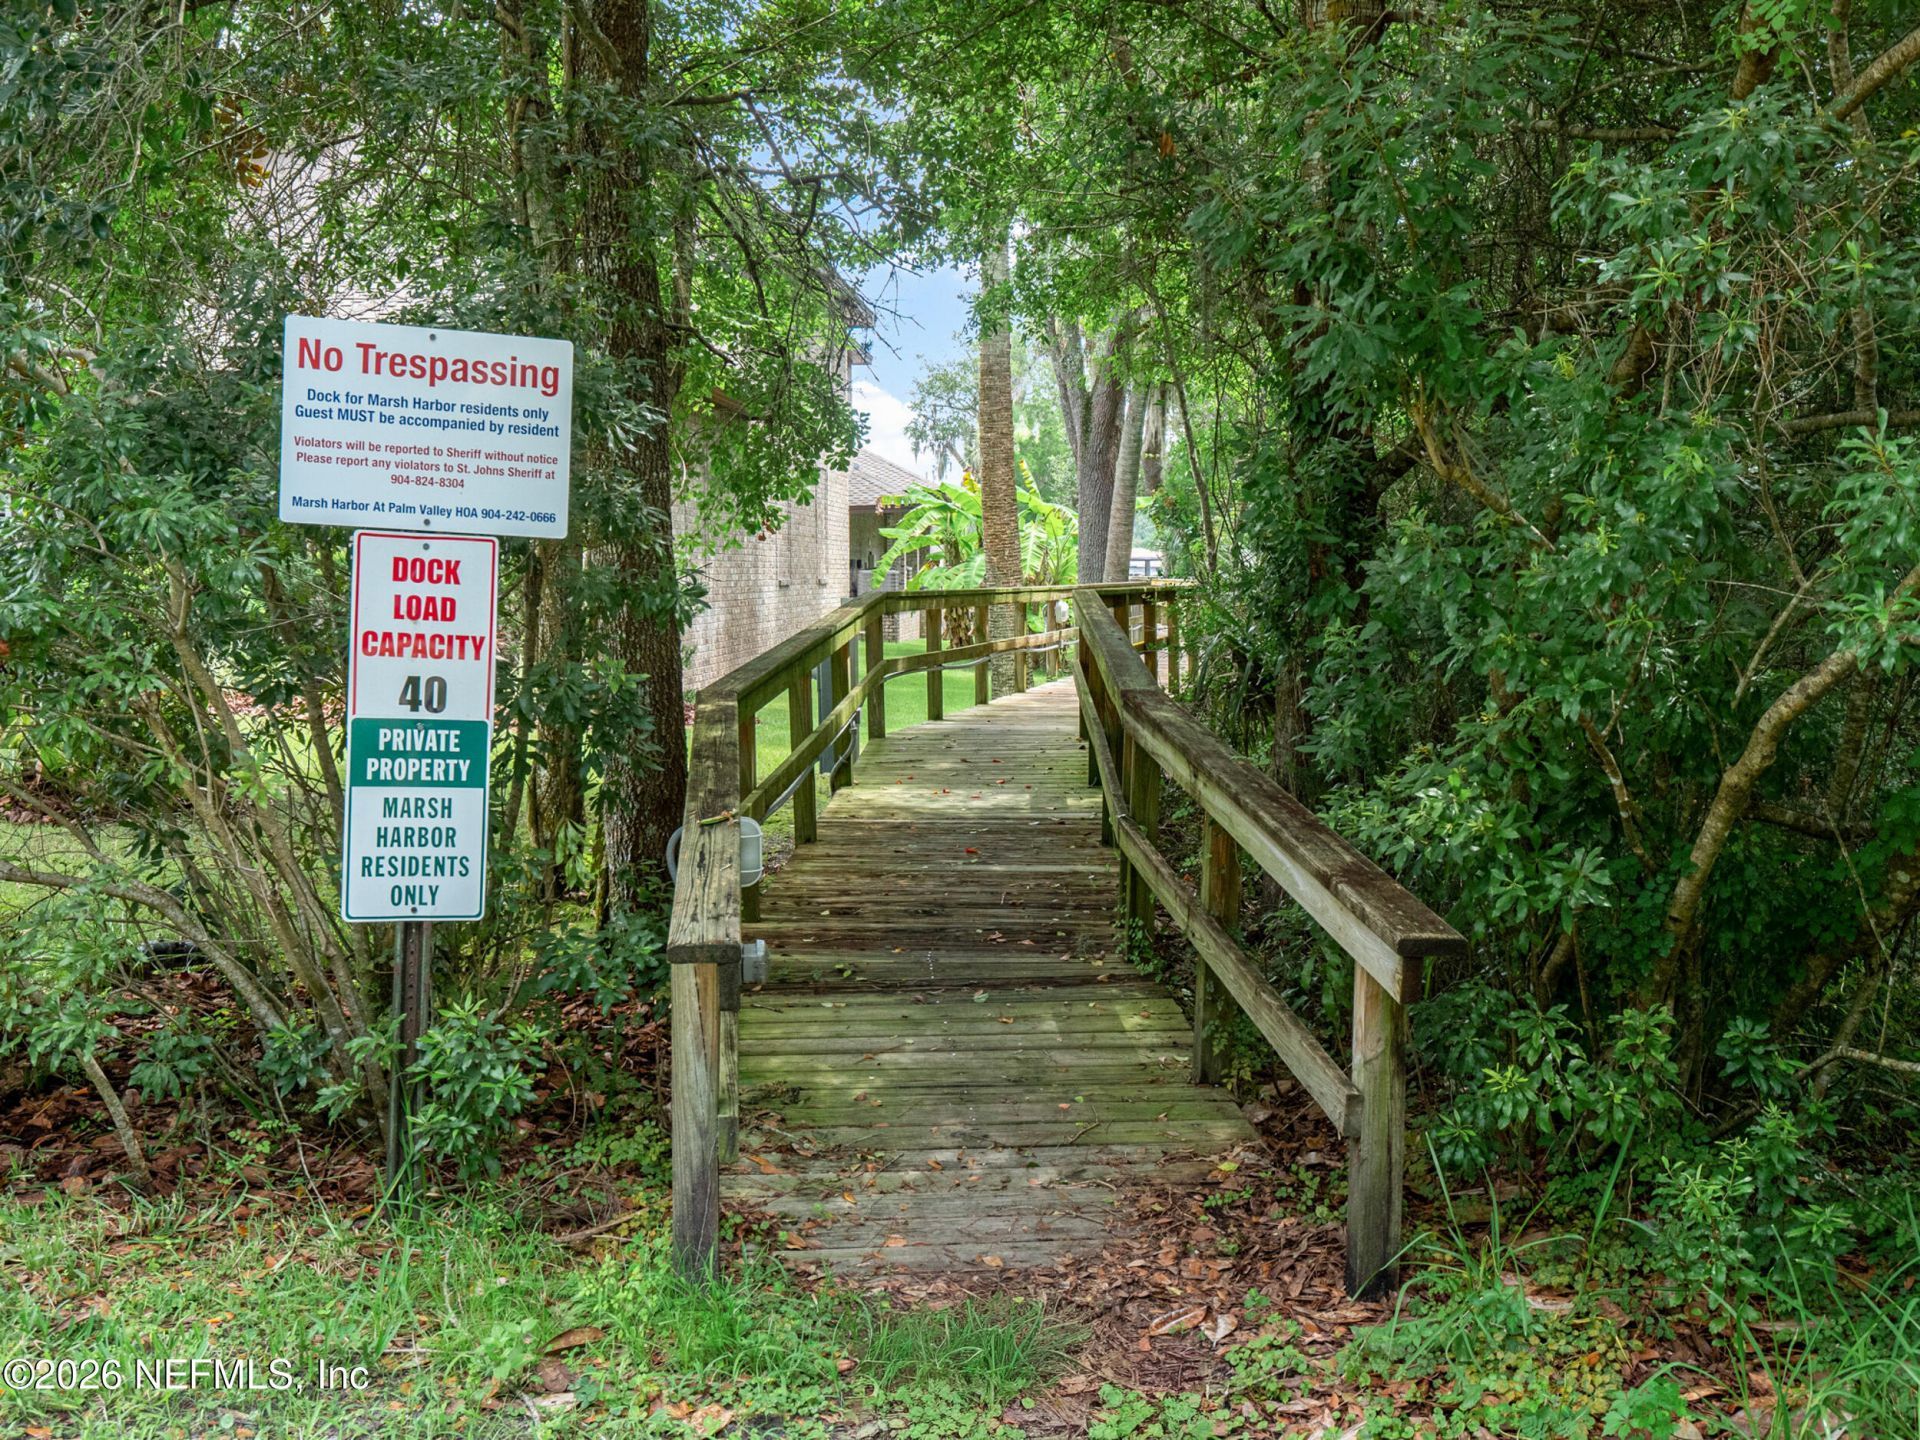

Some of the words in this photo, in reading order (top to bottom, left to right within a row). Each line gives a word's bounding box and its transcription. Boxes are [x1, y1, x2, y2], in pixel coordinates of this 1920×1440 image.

[298, 338, 343, 372] No
[356, 342, 560, 397] Trespassing
[307, 388, 340, 403] Dock
[345, 392, 363, 404] for
[368, 393, 408, 408] Marsh
[413, 397, 456, 412] Harbor
[460, 400, 519, 417] residents
[522, 406, 549, 421] only
[295, 404, 333, 420] Guest
[337, 410, 374, 422] MUST
[379, 412, 394, 424] be
[399, 415, 485, 434] accompanied
[489, 418, 504, 434] by
[508, 422, 560, 437] resident
[294, 436, 342, 450] Violators
[346, 440, 365, 451] will
[368, 441, 381, 452] be
[385, 442, 429, 458] reported
[433, 446, 443, 457] to
[446, 448, 481, 459] Sheriff
[484, 449, 524, 462] without
[527, 453, 558, 464] notice
[296, 452, 332, 464] Please
[336, 456, 368, 468] report
[372, 460, 391, 470] any
[394, 459, 440, 472] violators
[444, 463, 454, 473] to
[457, 464, 471, 474] St.
[473, 464, 504, 476] Johns
[507, 467, 542, 478] Sheriff
[545, 470, 555, 480] at
[390, 474, 464, 488] 904-824-8304
[292, 496, 328, 508] Marsh
[331, 500, 369, 512] Harbor
[373, 502, 387, 512] At
[388, 502, 416, 514] Palm
[419, 504, 452, 518] Valley
[455, 507, 478, 518] HOA
[481, 508, 556, 523] 904-242-0666
[392, 557, 462, 585] DOCK
[393, 594, 456, 622] LOAD
[362, 631, 486, 660] CAPACITY
[398, 675, 448, 713] 40
[379, 729, 461, 753] PRIVATE
[366, 757, 471, 782] PROPERTY
[383, 797, 453, 819] MARSH
[376, 827, 457, 848] HARBOR
[361, 855, 470, 877] RESIDENTS
[391, 885, 440, 906] ONLY
